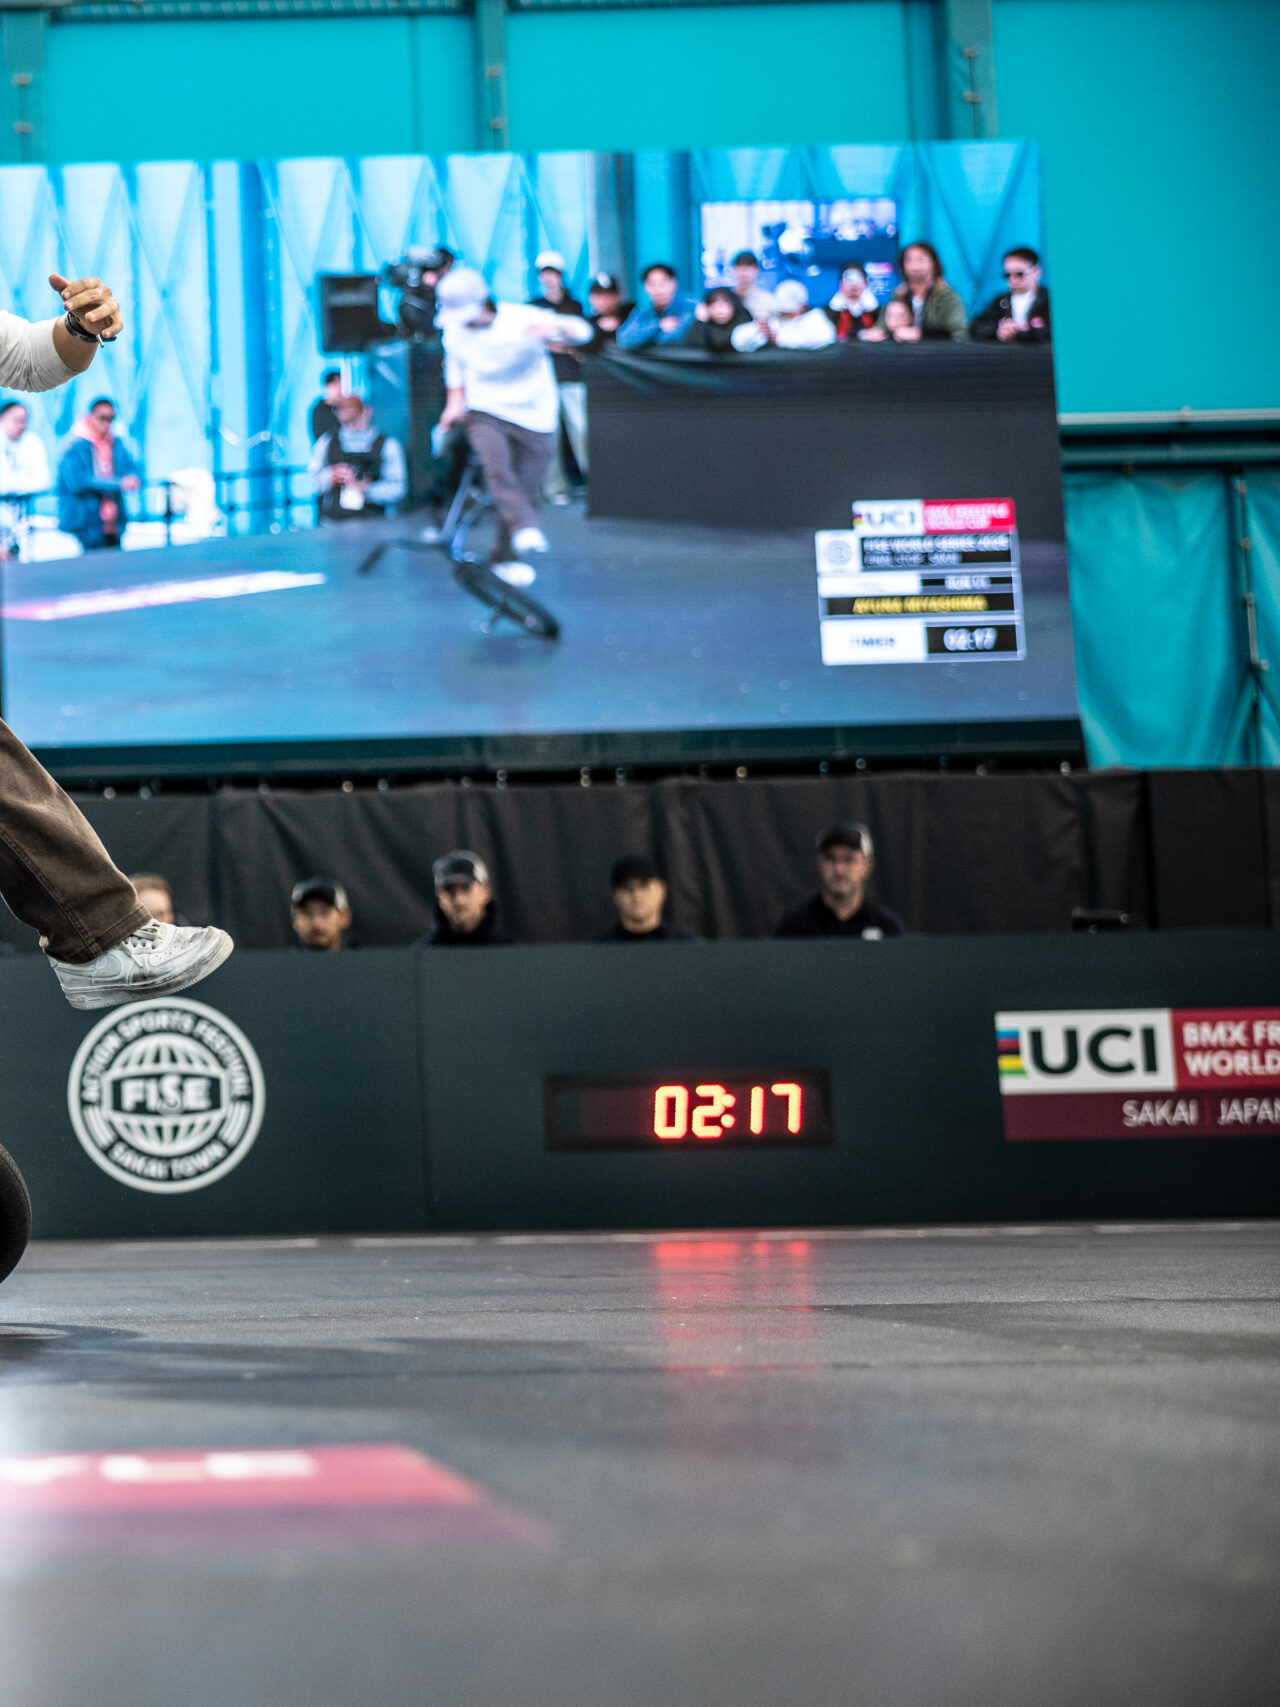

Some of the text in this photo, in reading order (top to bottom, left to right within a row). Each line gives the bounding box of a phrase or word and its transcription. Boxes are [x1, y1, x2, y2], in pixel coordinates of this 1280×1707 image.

[116, 1009, 195, 1039] SPORTS
[1182, 1020, 1247, 1048] BMX
[1027, 1025, 1159, 1076] UCI
[1183, 1049, 1280, 1077] WORLD
[121, 1074, 213, 1115] FISE
[653, 1083, 803, 1140] 02:17
[1122, 1099, 1198, 1127] SAKAI
[169, 1139, 230, 1179] TOWN
